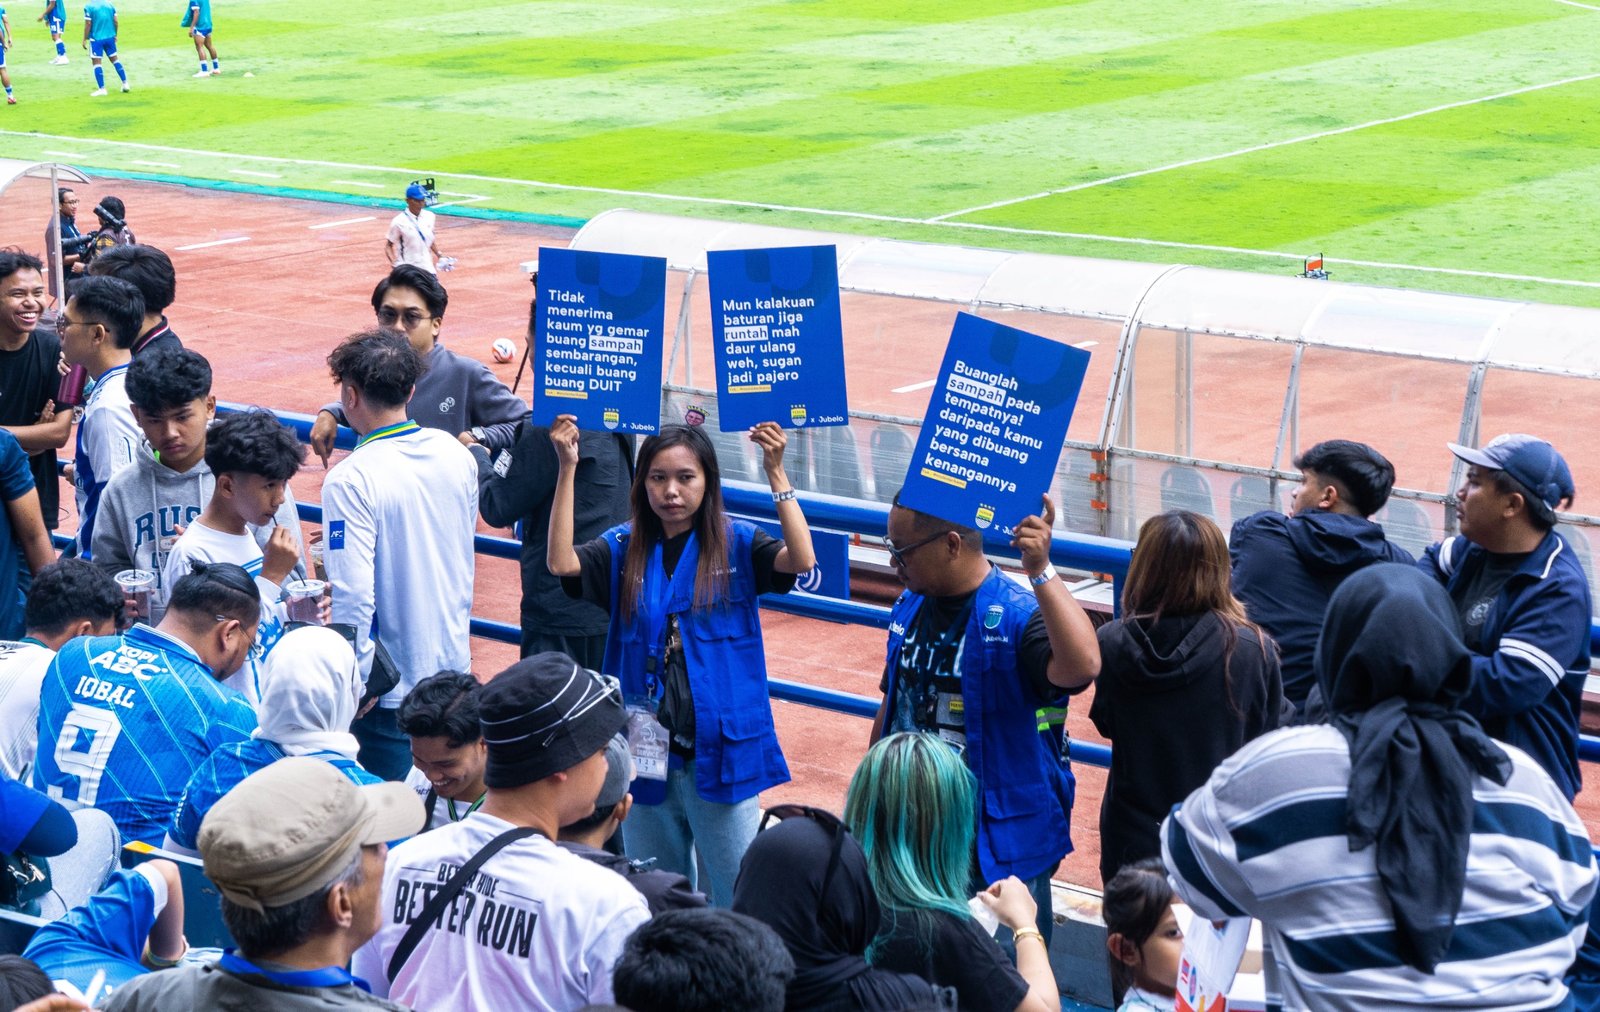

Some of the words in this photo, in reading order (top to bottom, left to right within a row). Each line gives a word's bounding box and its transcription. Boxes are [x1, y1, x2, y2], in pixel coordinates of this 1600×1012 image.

[548, 289, 585, 303] Tidak
[722, 299, 751, 311] Mun
[755, 296, 815, 309] kalakuan
[547, 306, 613, 320] menerima
[723, 314, 774, 326] baturan
[778, 311, 803, 325] jiga
[547, 318, 583, 332] kaum
[587, 324, 603, 335] yg
[607, 326, 650, 337] gemar
[725, 327, 767, 340] runtah
[772, 325, 800, 338] mah
[546, 332, 586, 348] buang
[591, 338, 641, 352] sampah
[726, 343, 755, 354] daur
[760, 341, 796, 354] ulang
[546, 348, 638, 367] sembarangan,
[727, 356, 758, 370] weh,
[762, 356, 802, 369] sugan
[545, 361, 592, 375] kecuali
[596, 365, 637, 381] buang
[728, 371, 752, 386] jadi
[756, 370, 799, 384] pajero
[953, 359, 1018, 391] Buanglah
[545, 375, 585, 391] buang
[589, 378, 622, 392] DUIT
[949, 377, 1004, 403] sampah
[1005, 396, 1041, 415] pada
[945, 391, 1025, 426] tempatnya!
[630, 422, 655, 431] Jubelo
[818, 415, 844, 423] Jubelo
[939, 407, 1001, 437] daripada
[1003, 426, 1043, 450] kamu
[929, 437, 990, 467] bersama
[935, 424, 969, 445] yang
[972, 433, 1029, 464] dibuang
[924, 452, 1017, 493] kenangannya
[116, 645, 159, 663] KOPI
[89, 650, 161, 681] ABC
[74, 675, 137, 709] IQBAL
[53, 702, 122, 812] 9
[477, 899, 538, 958] RUN
